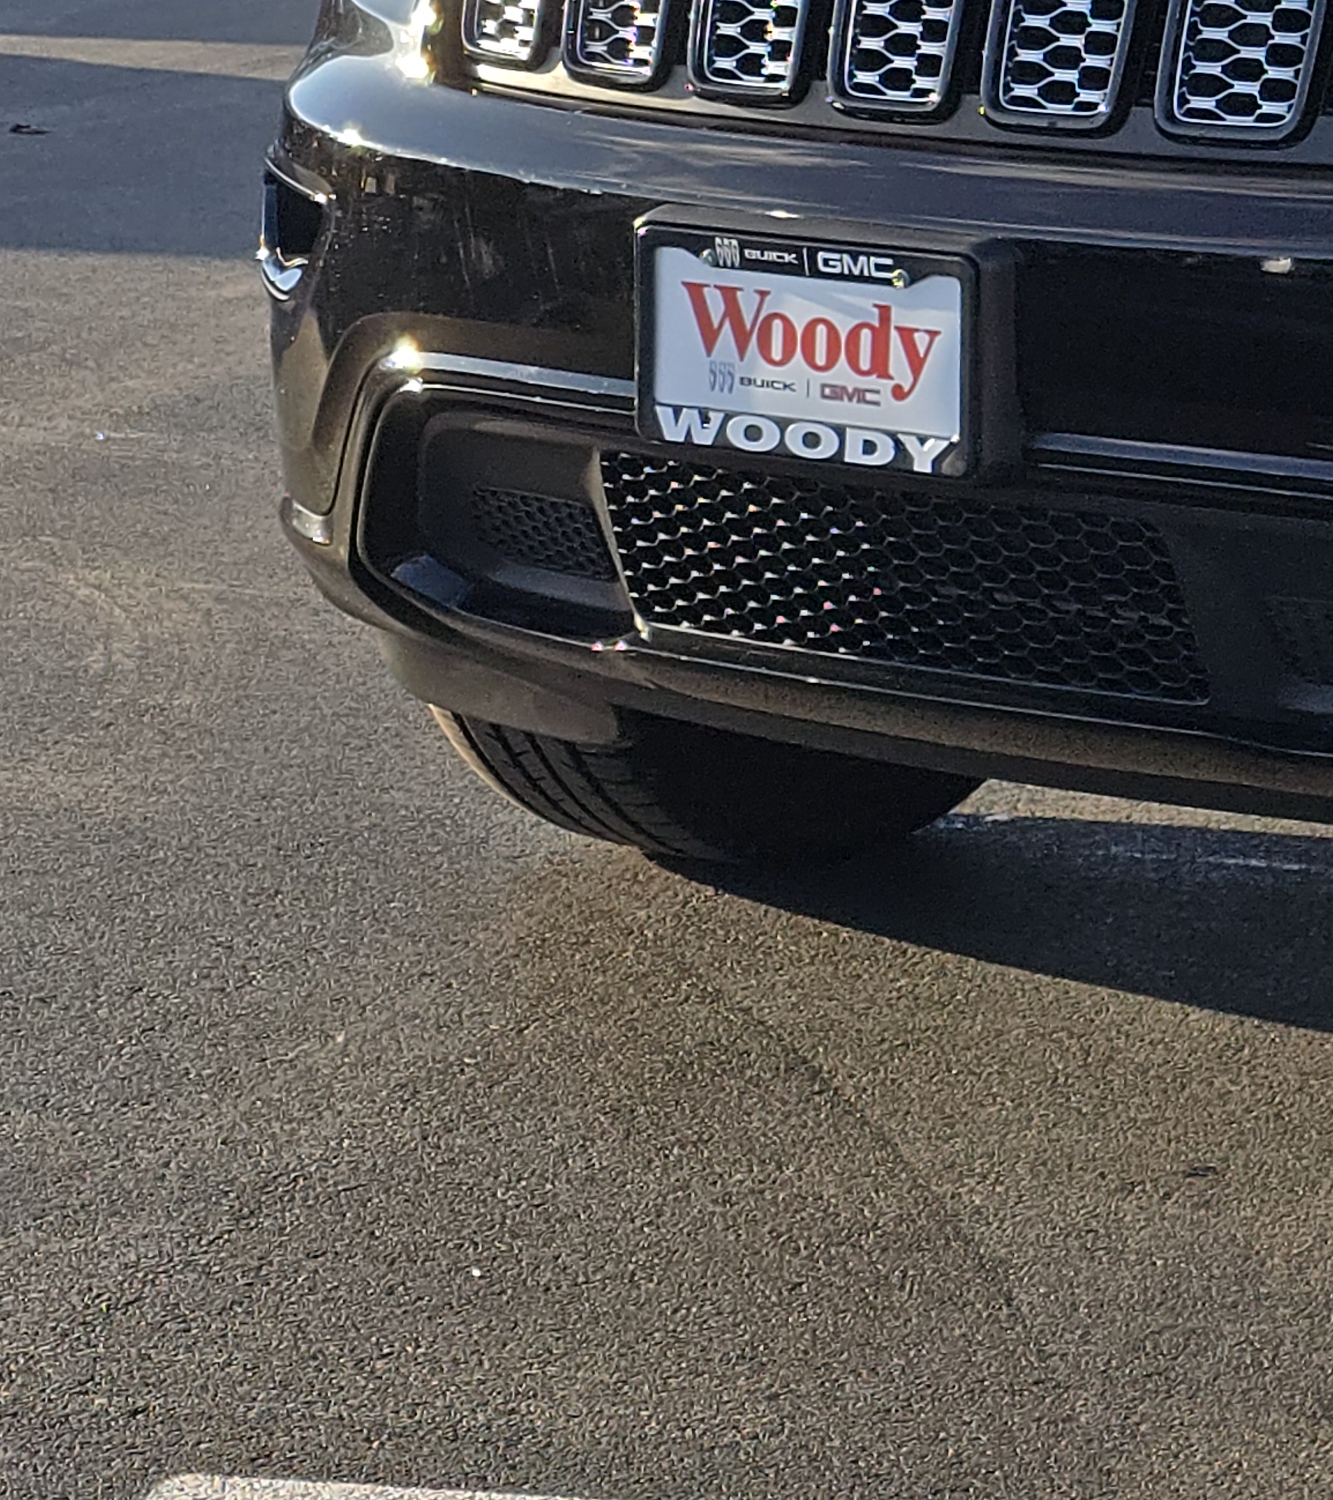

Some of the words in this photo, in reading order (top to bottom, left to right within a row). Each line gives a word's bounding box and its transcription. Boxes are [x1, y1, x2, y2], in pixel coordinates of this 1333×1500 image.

[743, 248, 799, 265] BUICK
[817, 250, 895, 279] GMC
[681, 281, 942, 401] Woody
[738, 376, 797, 393] BUICK
[819, 382, 882, 407] GMC
[654, 405, 953, 474] WOODY
